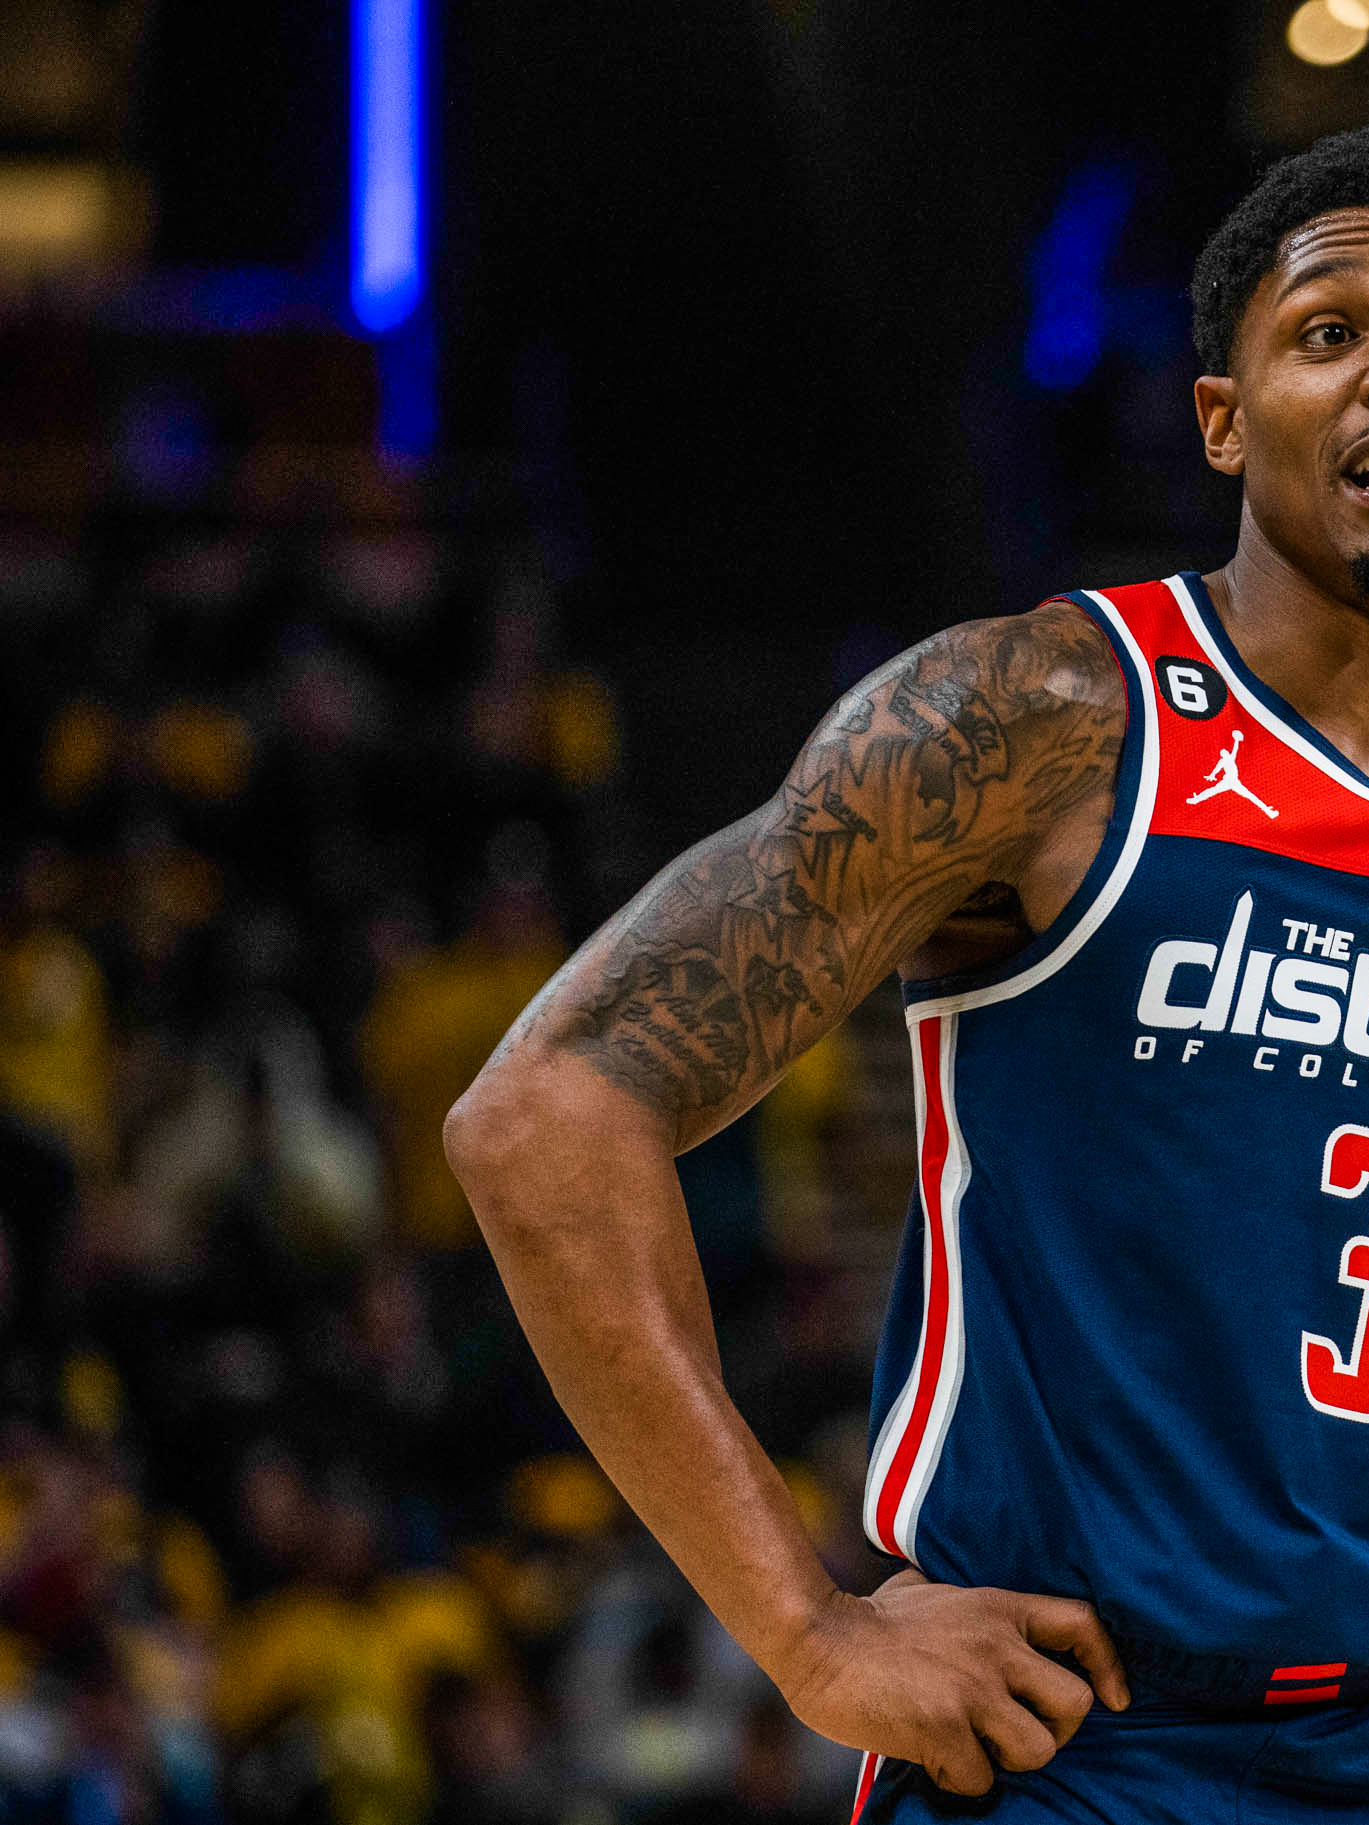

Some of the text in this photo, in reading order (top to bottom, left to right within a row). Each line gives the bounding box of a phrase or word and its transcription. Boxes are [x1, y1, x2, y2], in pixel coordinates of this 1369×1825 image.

[1166, 665, 1208, 713] 6
[1283, 918, 1355, 961] THE
[1133, 1036, 1204, 1065] OF
